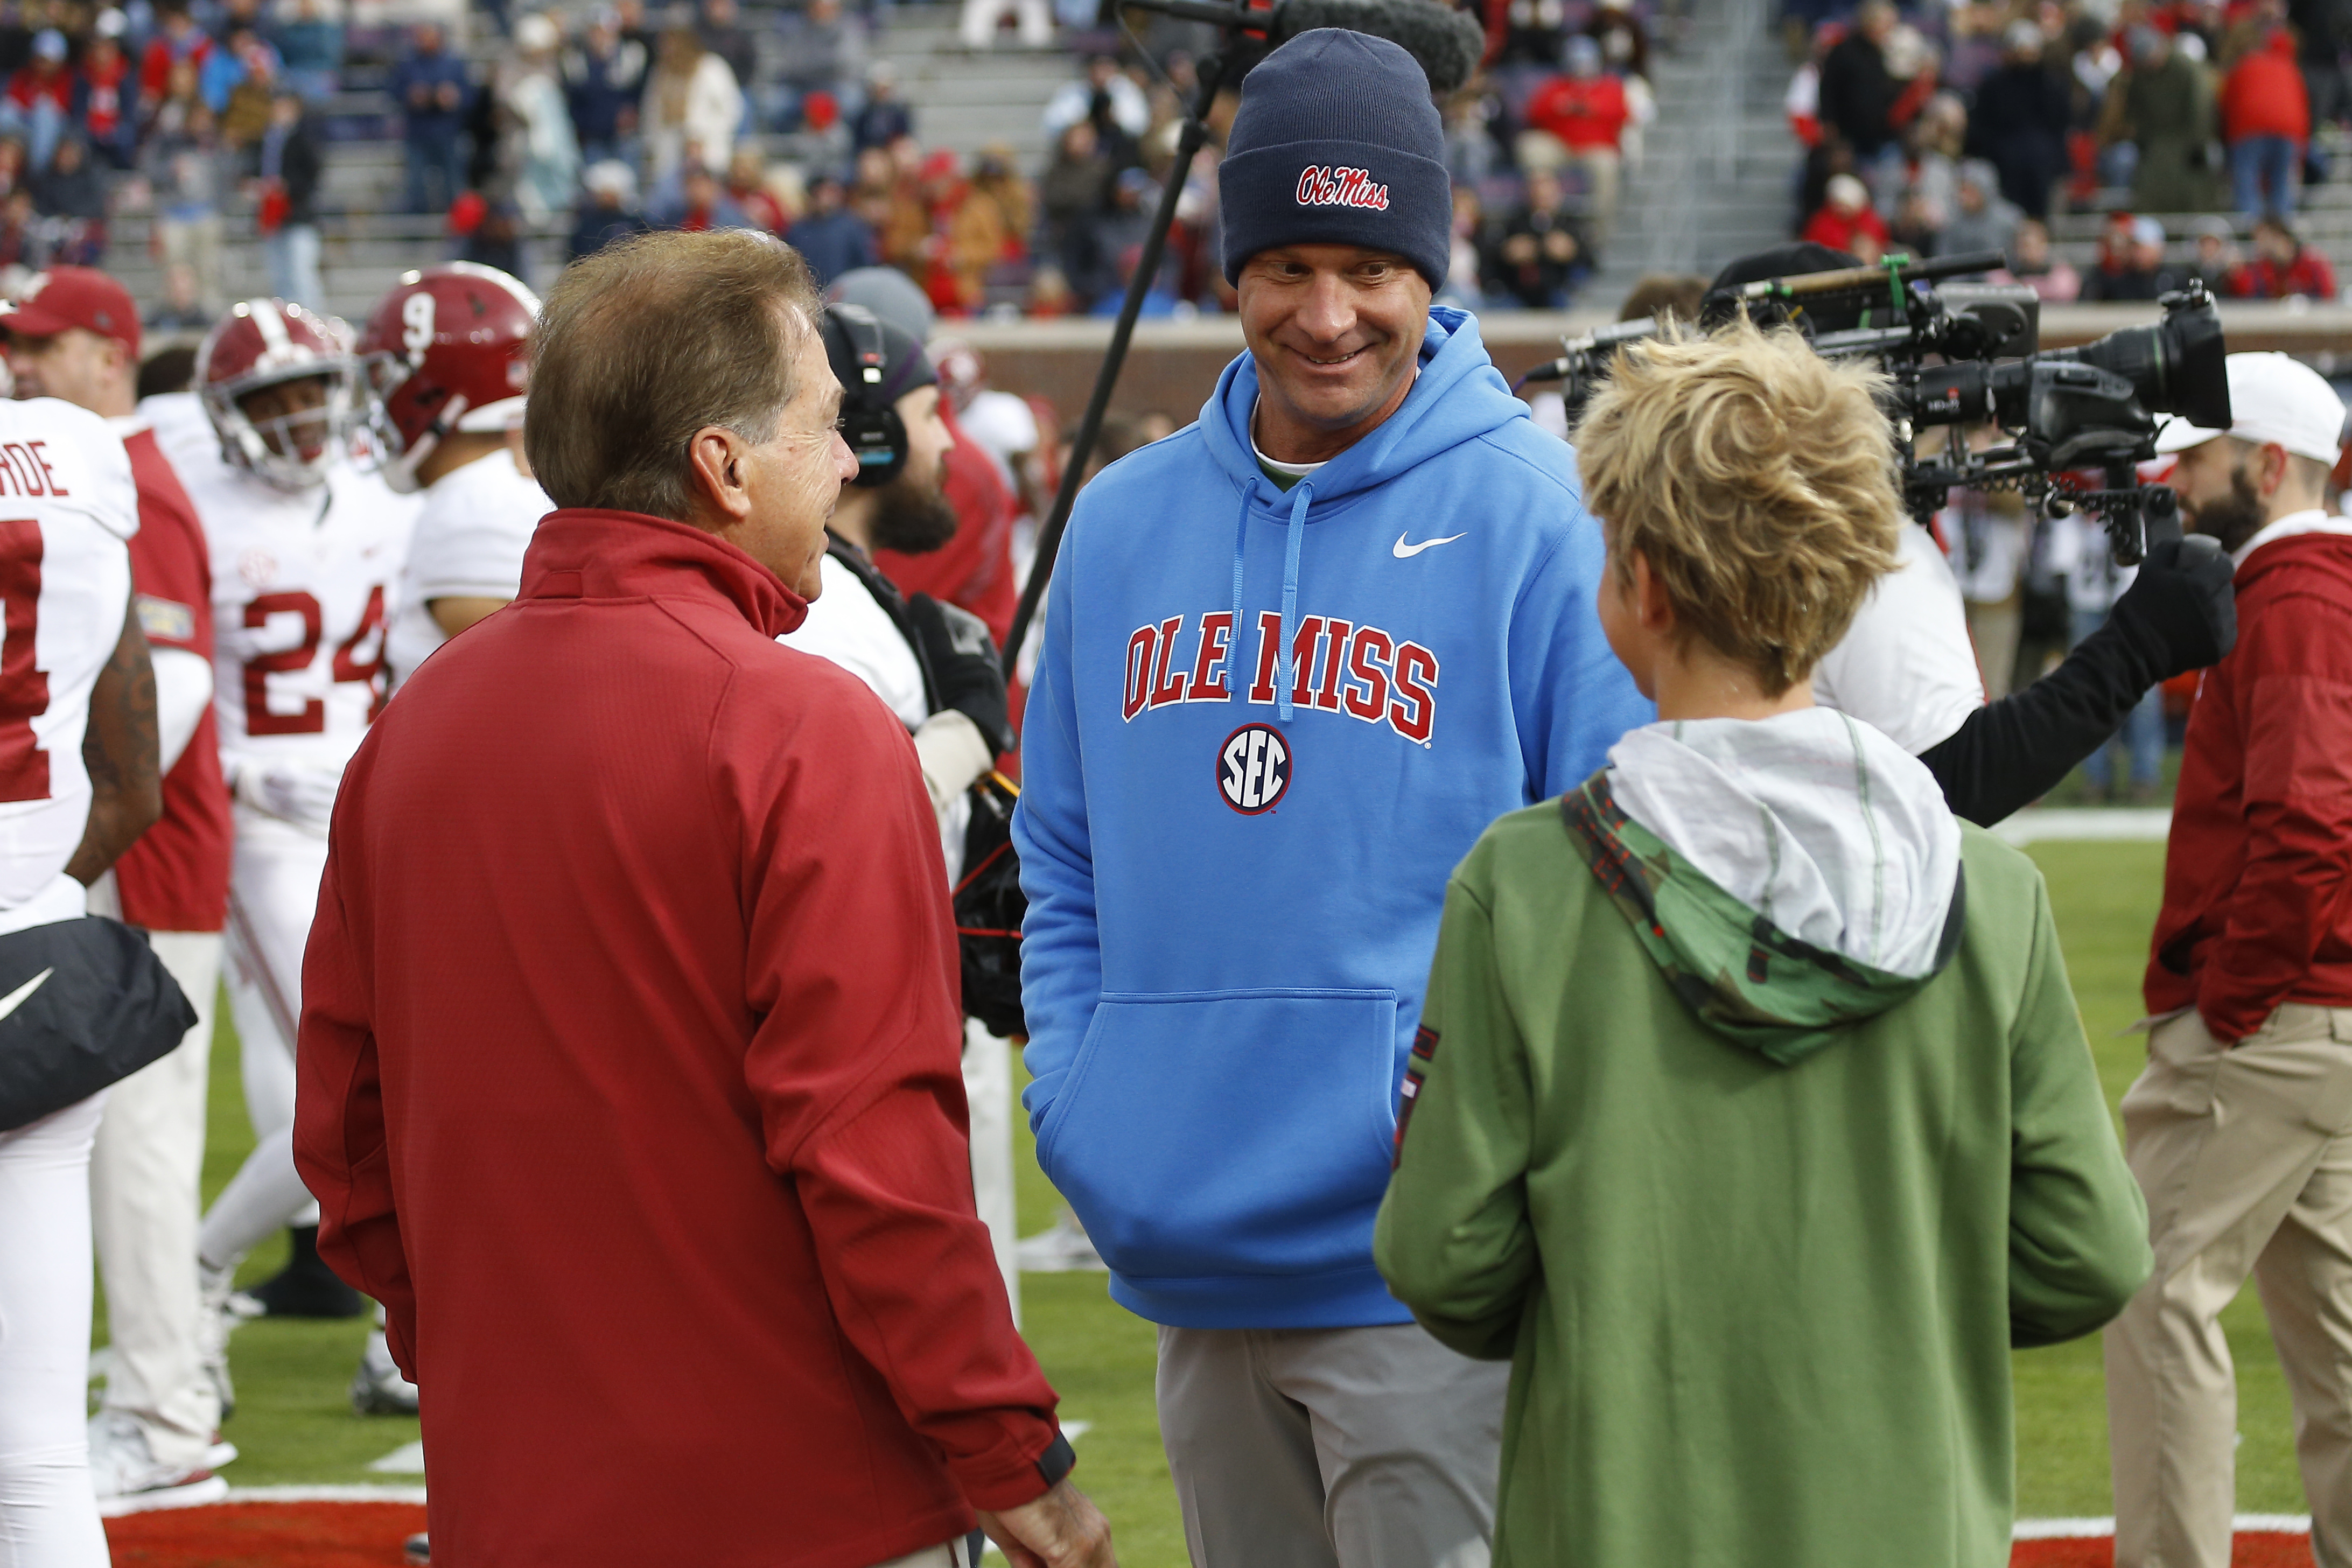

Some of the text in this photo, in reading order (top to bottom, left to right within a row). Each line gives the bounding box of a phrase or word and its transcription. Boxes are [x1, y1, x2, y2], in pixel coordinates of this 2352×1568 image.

[1296, 165, 1390, 211] Ole Miss
[402, 291, 436, 351] 9
[244, 585, 386, 737] 24
[1122, 609, 1440, 745] OLE MISS
[1222, 729, 1286, 808] SEC
